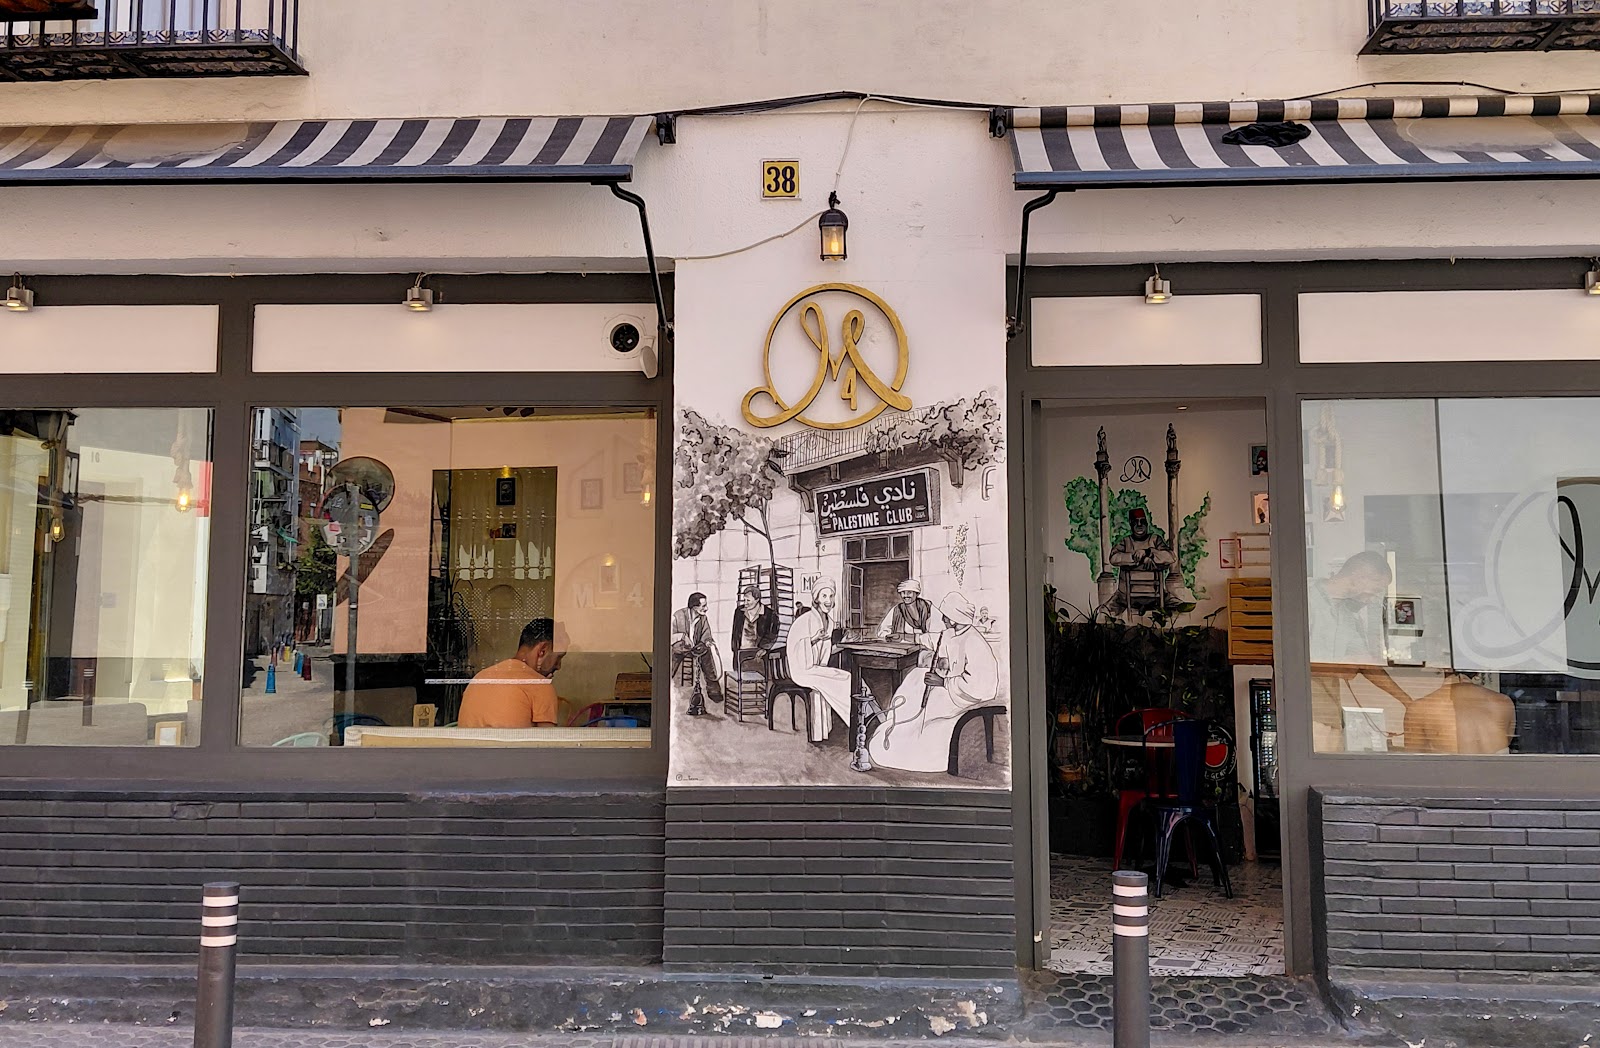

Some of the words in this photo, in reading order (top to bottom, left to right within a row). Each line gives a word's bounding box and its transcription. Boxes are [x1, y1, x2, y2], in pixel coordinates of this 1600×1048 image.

[766, 165, 796, 193] 38
[873, 477, 916, 510] نادي
[832, 511, 880, 532] PALESTINE
[886, 507, 913, 525] CLUB
